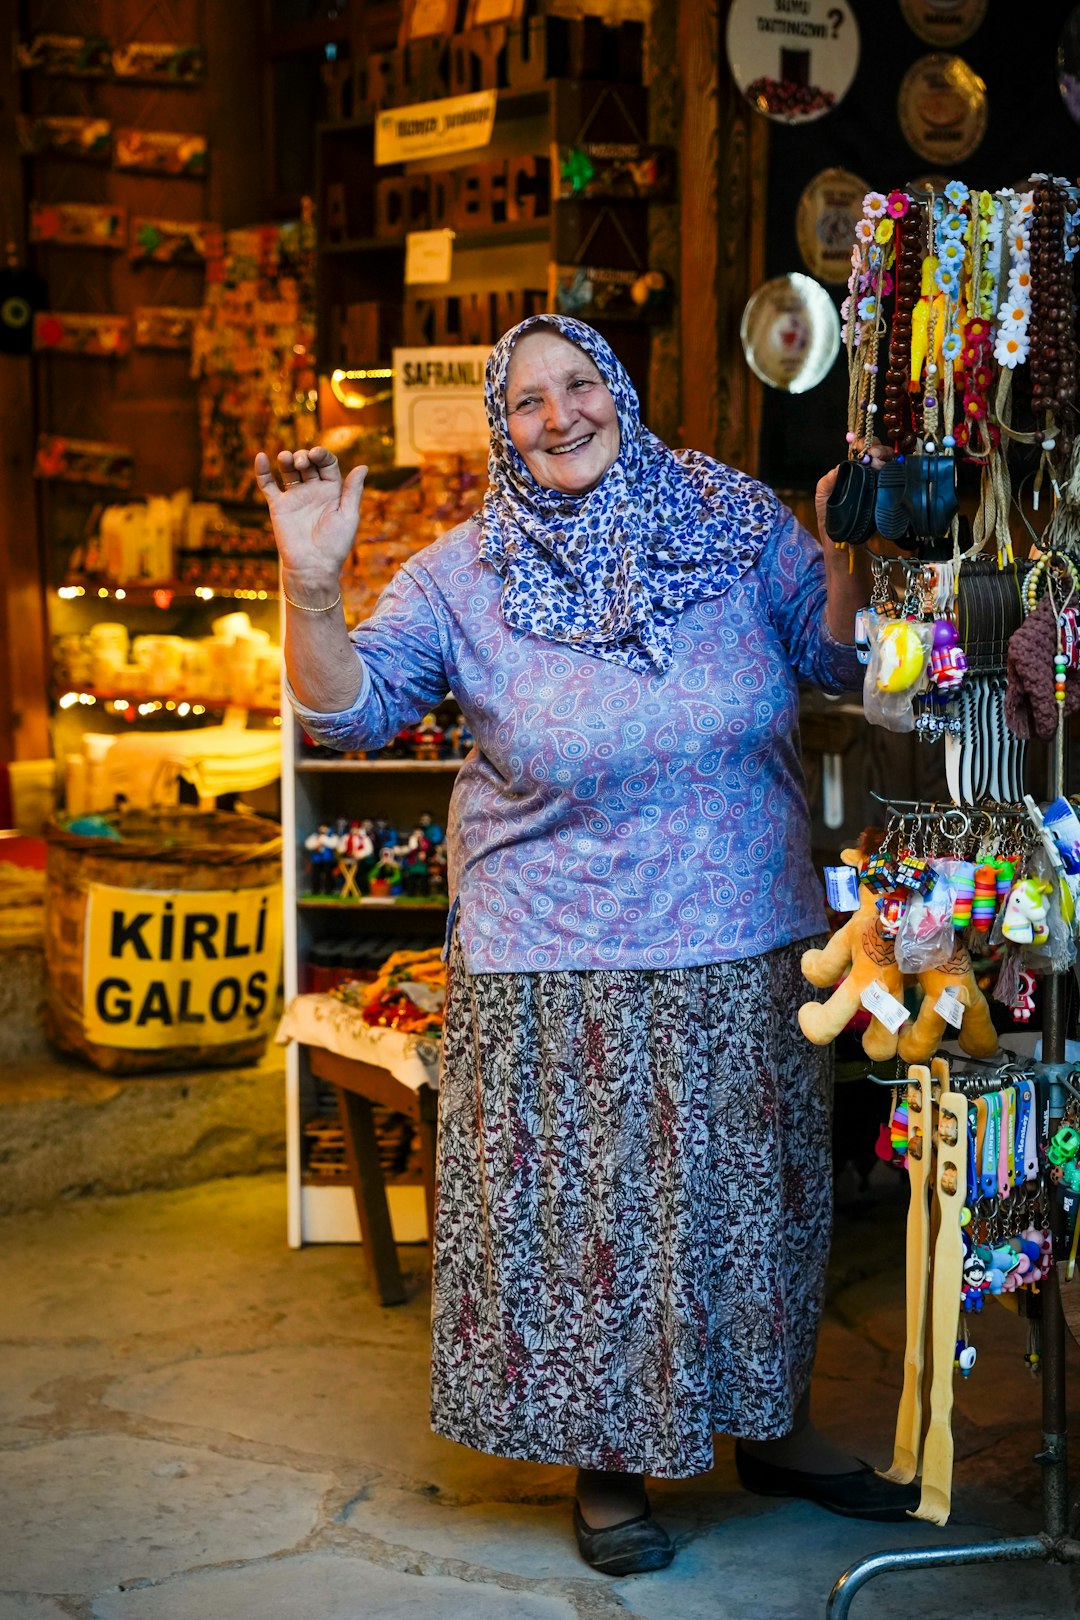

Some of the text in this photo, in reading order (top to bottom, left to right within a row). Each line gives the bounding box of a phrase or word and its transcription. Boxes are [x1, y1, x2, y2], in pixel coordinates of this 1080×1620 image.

[110, 896, 269, 961] KİRLİ
[95, 970, 268, 1030] GALOŞ
[987, 1119, 995, 1162] RAINBOW
[1017, 1114, 1029, 1154] Monkey
